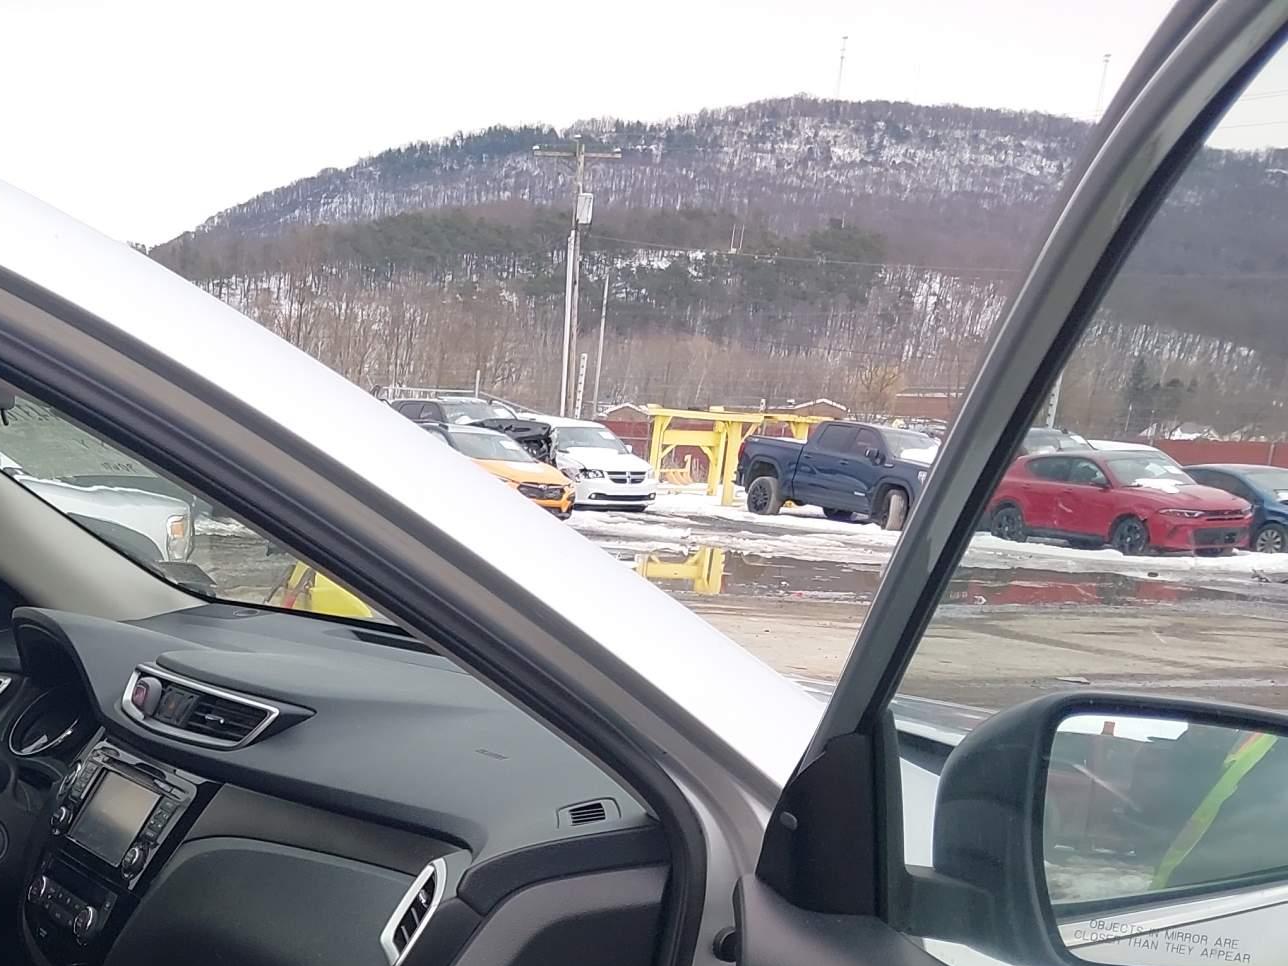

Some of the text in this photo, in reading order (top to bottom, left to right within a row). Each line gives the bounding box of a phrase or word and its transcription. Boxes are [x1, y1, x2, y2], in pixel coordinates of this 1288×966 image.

[1127, 937, 1159, 952] THAN
[1165, 942, 1194, 956] THEY
[1200, 948, 1251, 964] APPEAR
[1165, 929, 1208, 945] MIRROR
[1214, 936, 1240, 950] ARE
